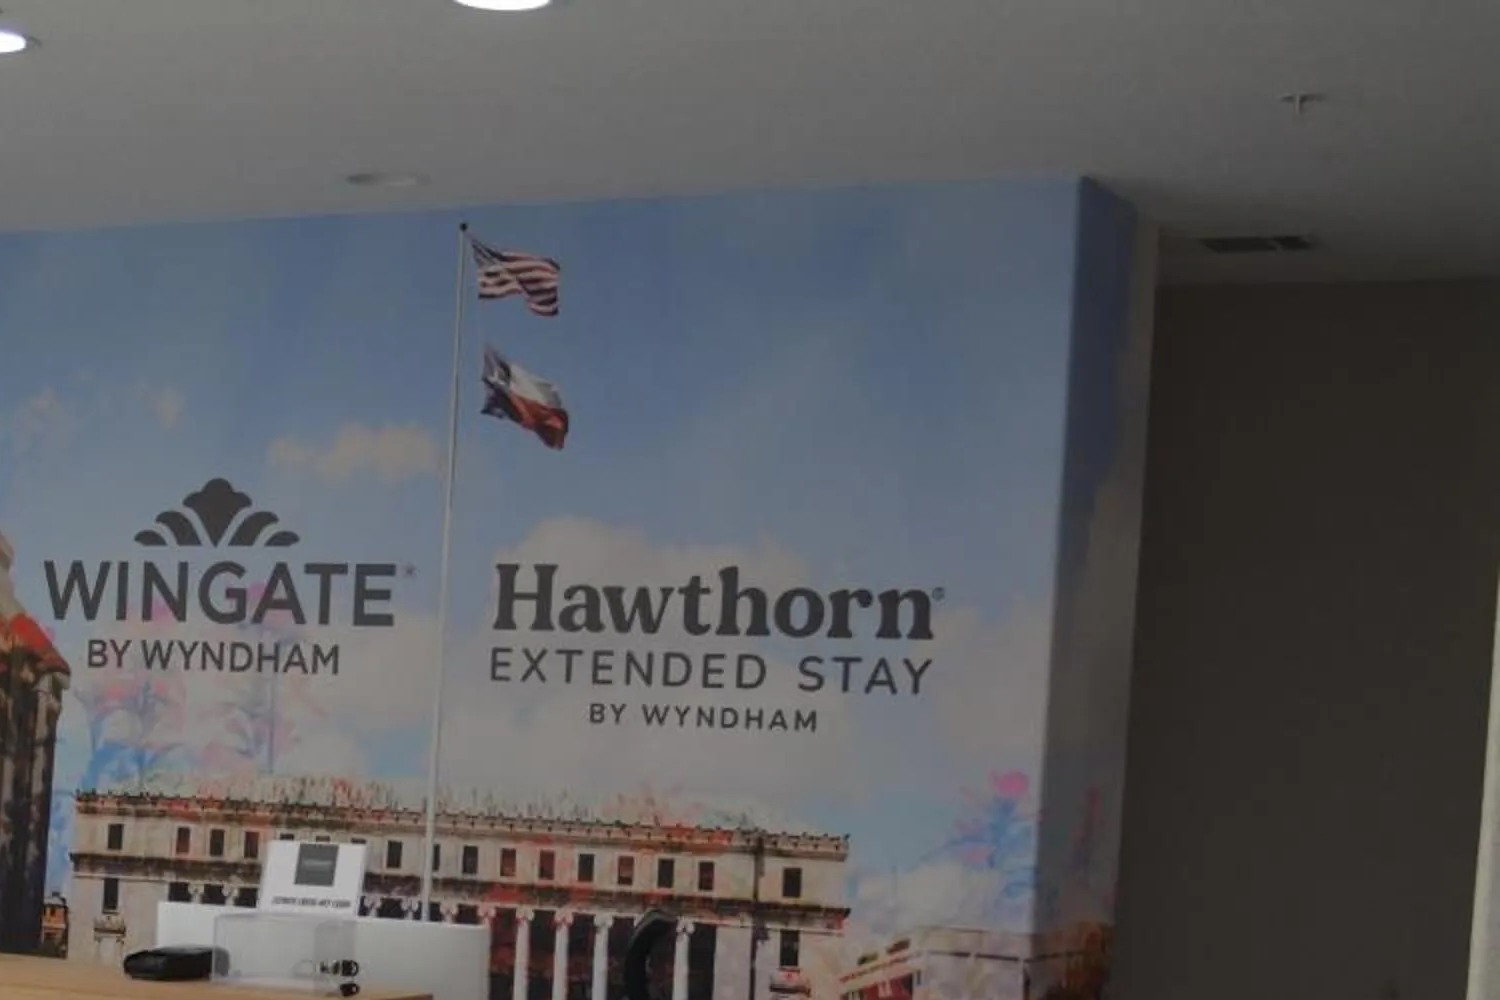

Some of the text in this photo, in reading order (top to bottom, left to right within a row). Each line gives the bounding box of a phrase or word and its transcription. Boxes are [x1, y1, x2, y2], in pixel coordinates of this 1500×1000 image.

[44, 560, 397, 627] WINGATE
[492, 563, 935, 640] Hawthorn
[87, 639, 340, 675] BY WYNDHAM
[490, 647, 933, 695] EXTENDED STAY
[589, 703, 818, 733] BY WYNDHAM
